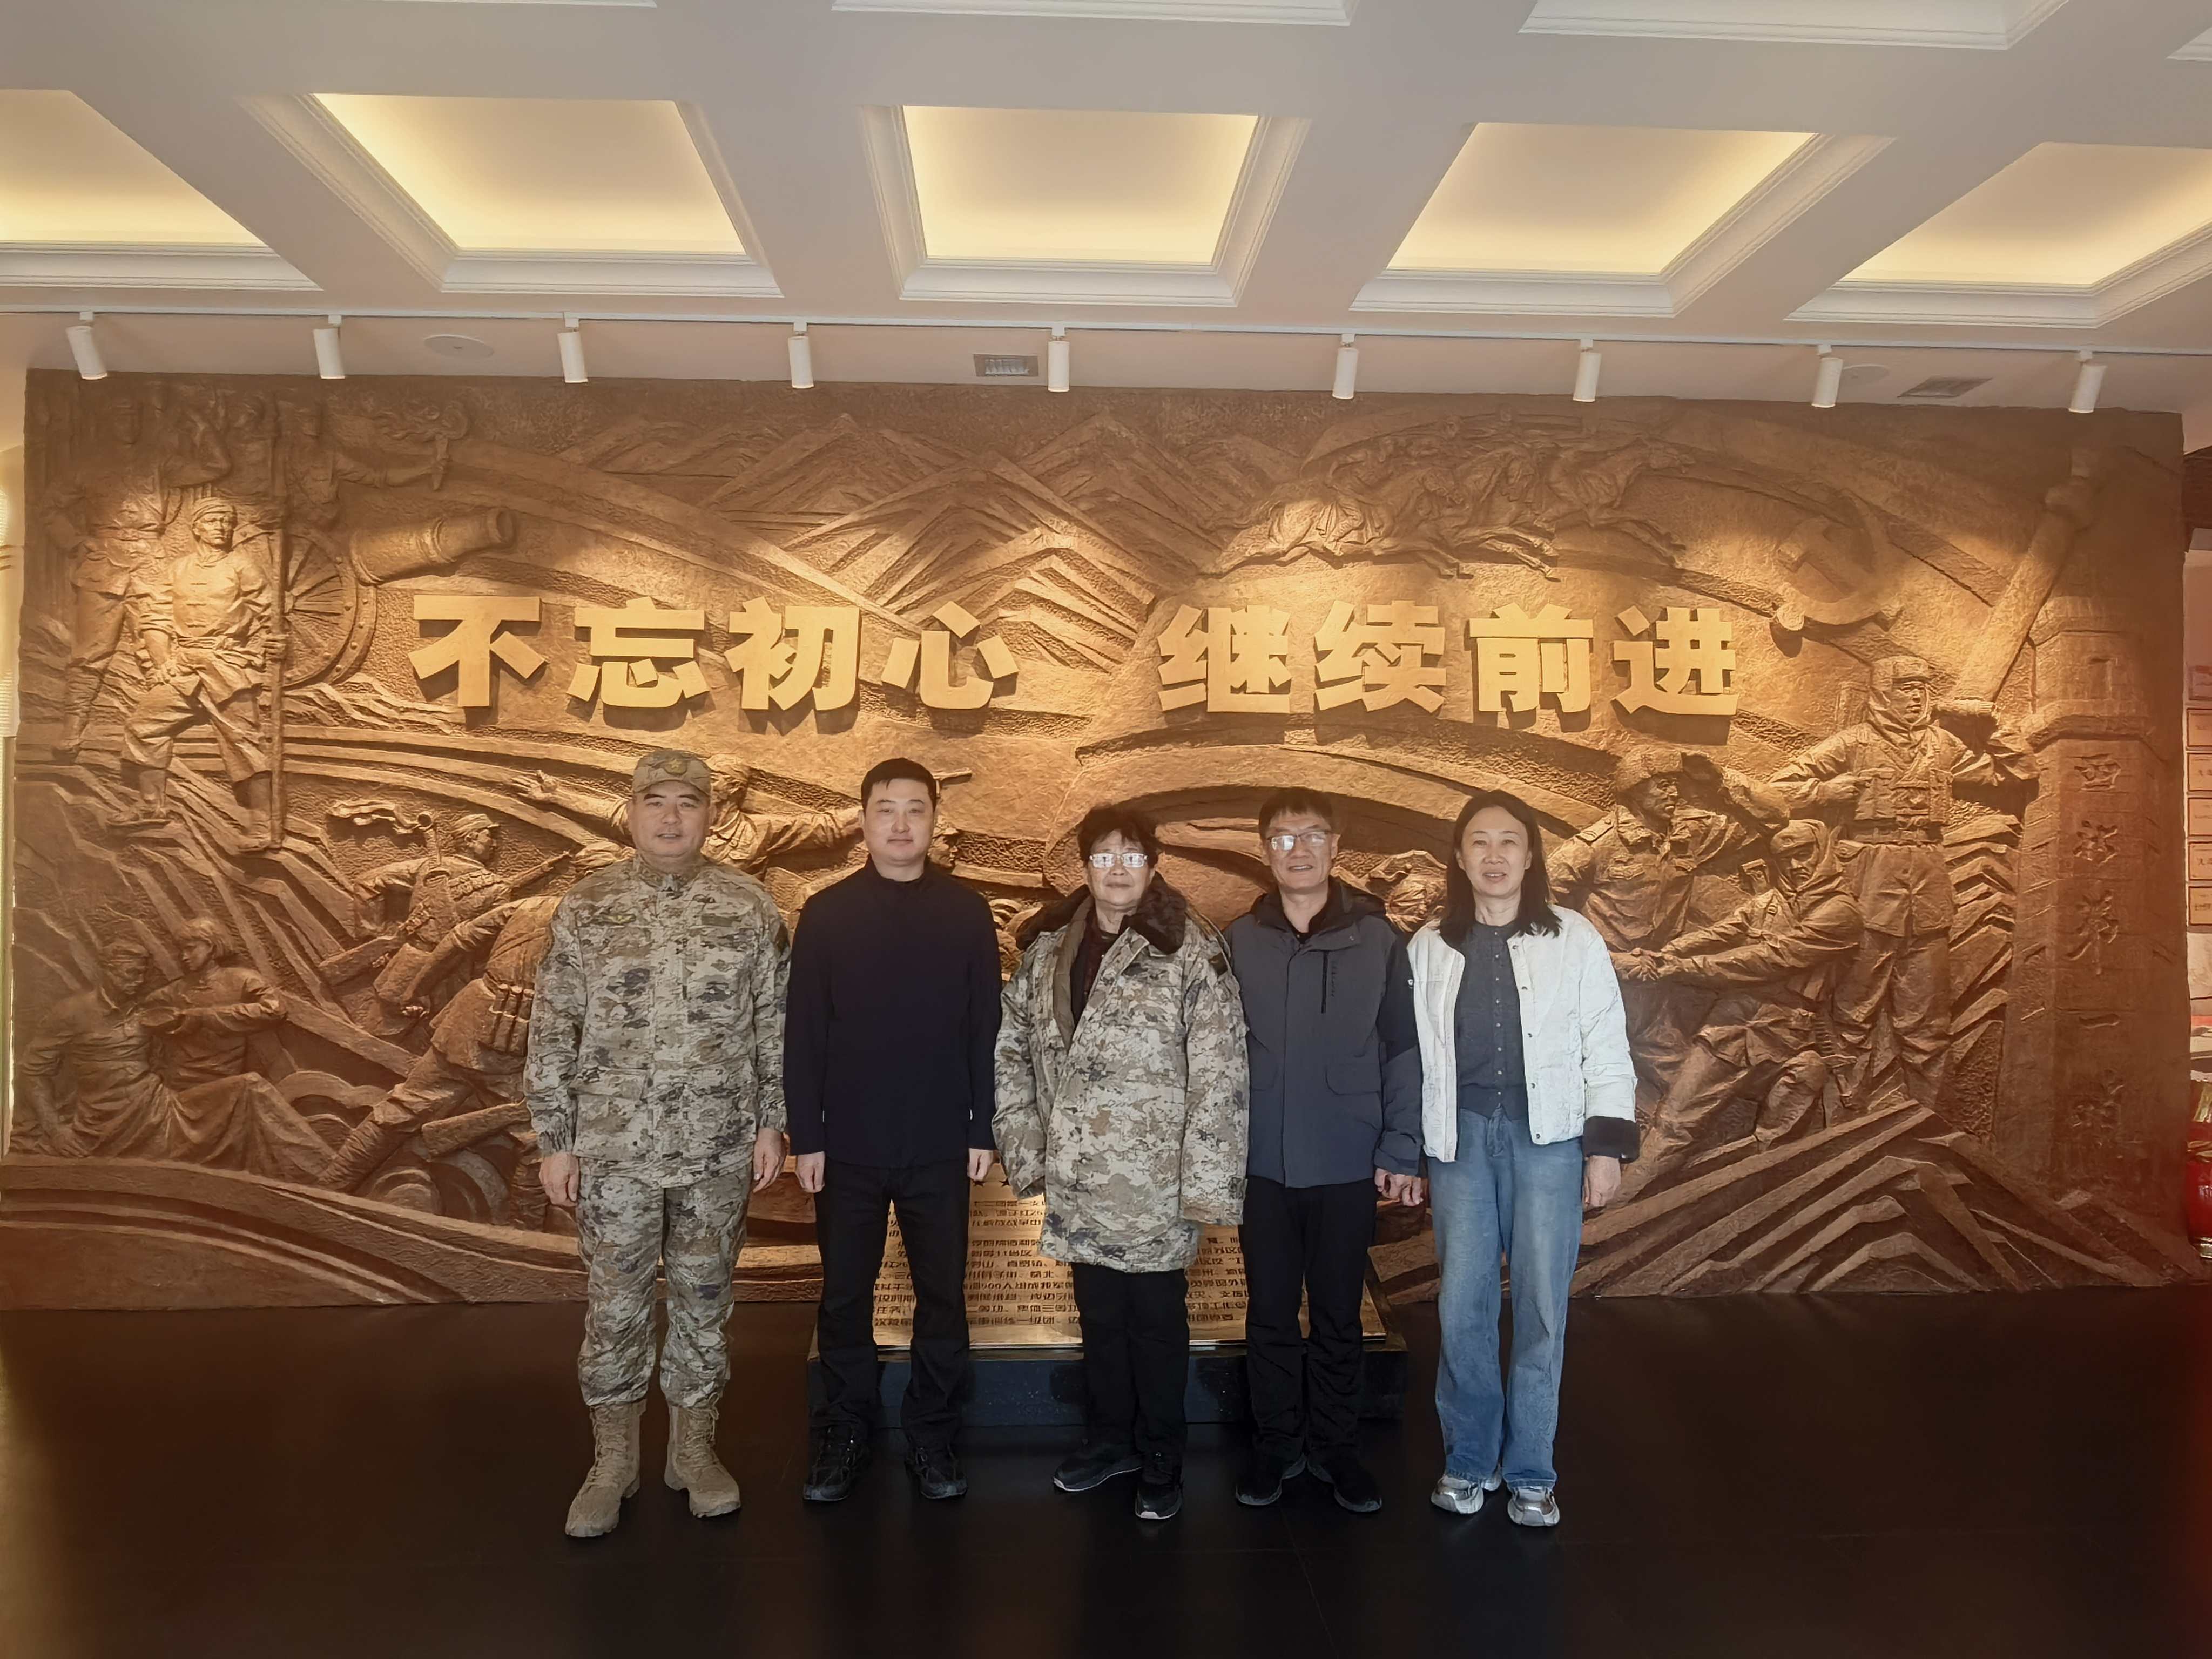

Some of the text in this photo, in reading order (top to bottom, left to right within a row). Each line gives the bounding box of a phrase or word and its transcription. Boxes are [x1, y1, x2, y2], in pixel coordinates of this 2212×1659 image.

[408, 595, 1019, 711] 不忘初心
[1157, 599, 1739, 716] 继续前进
